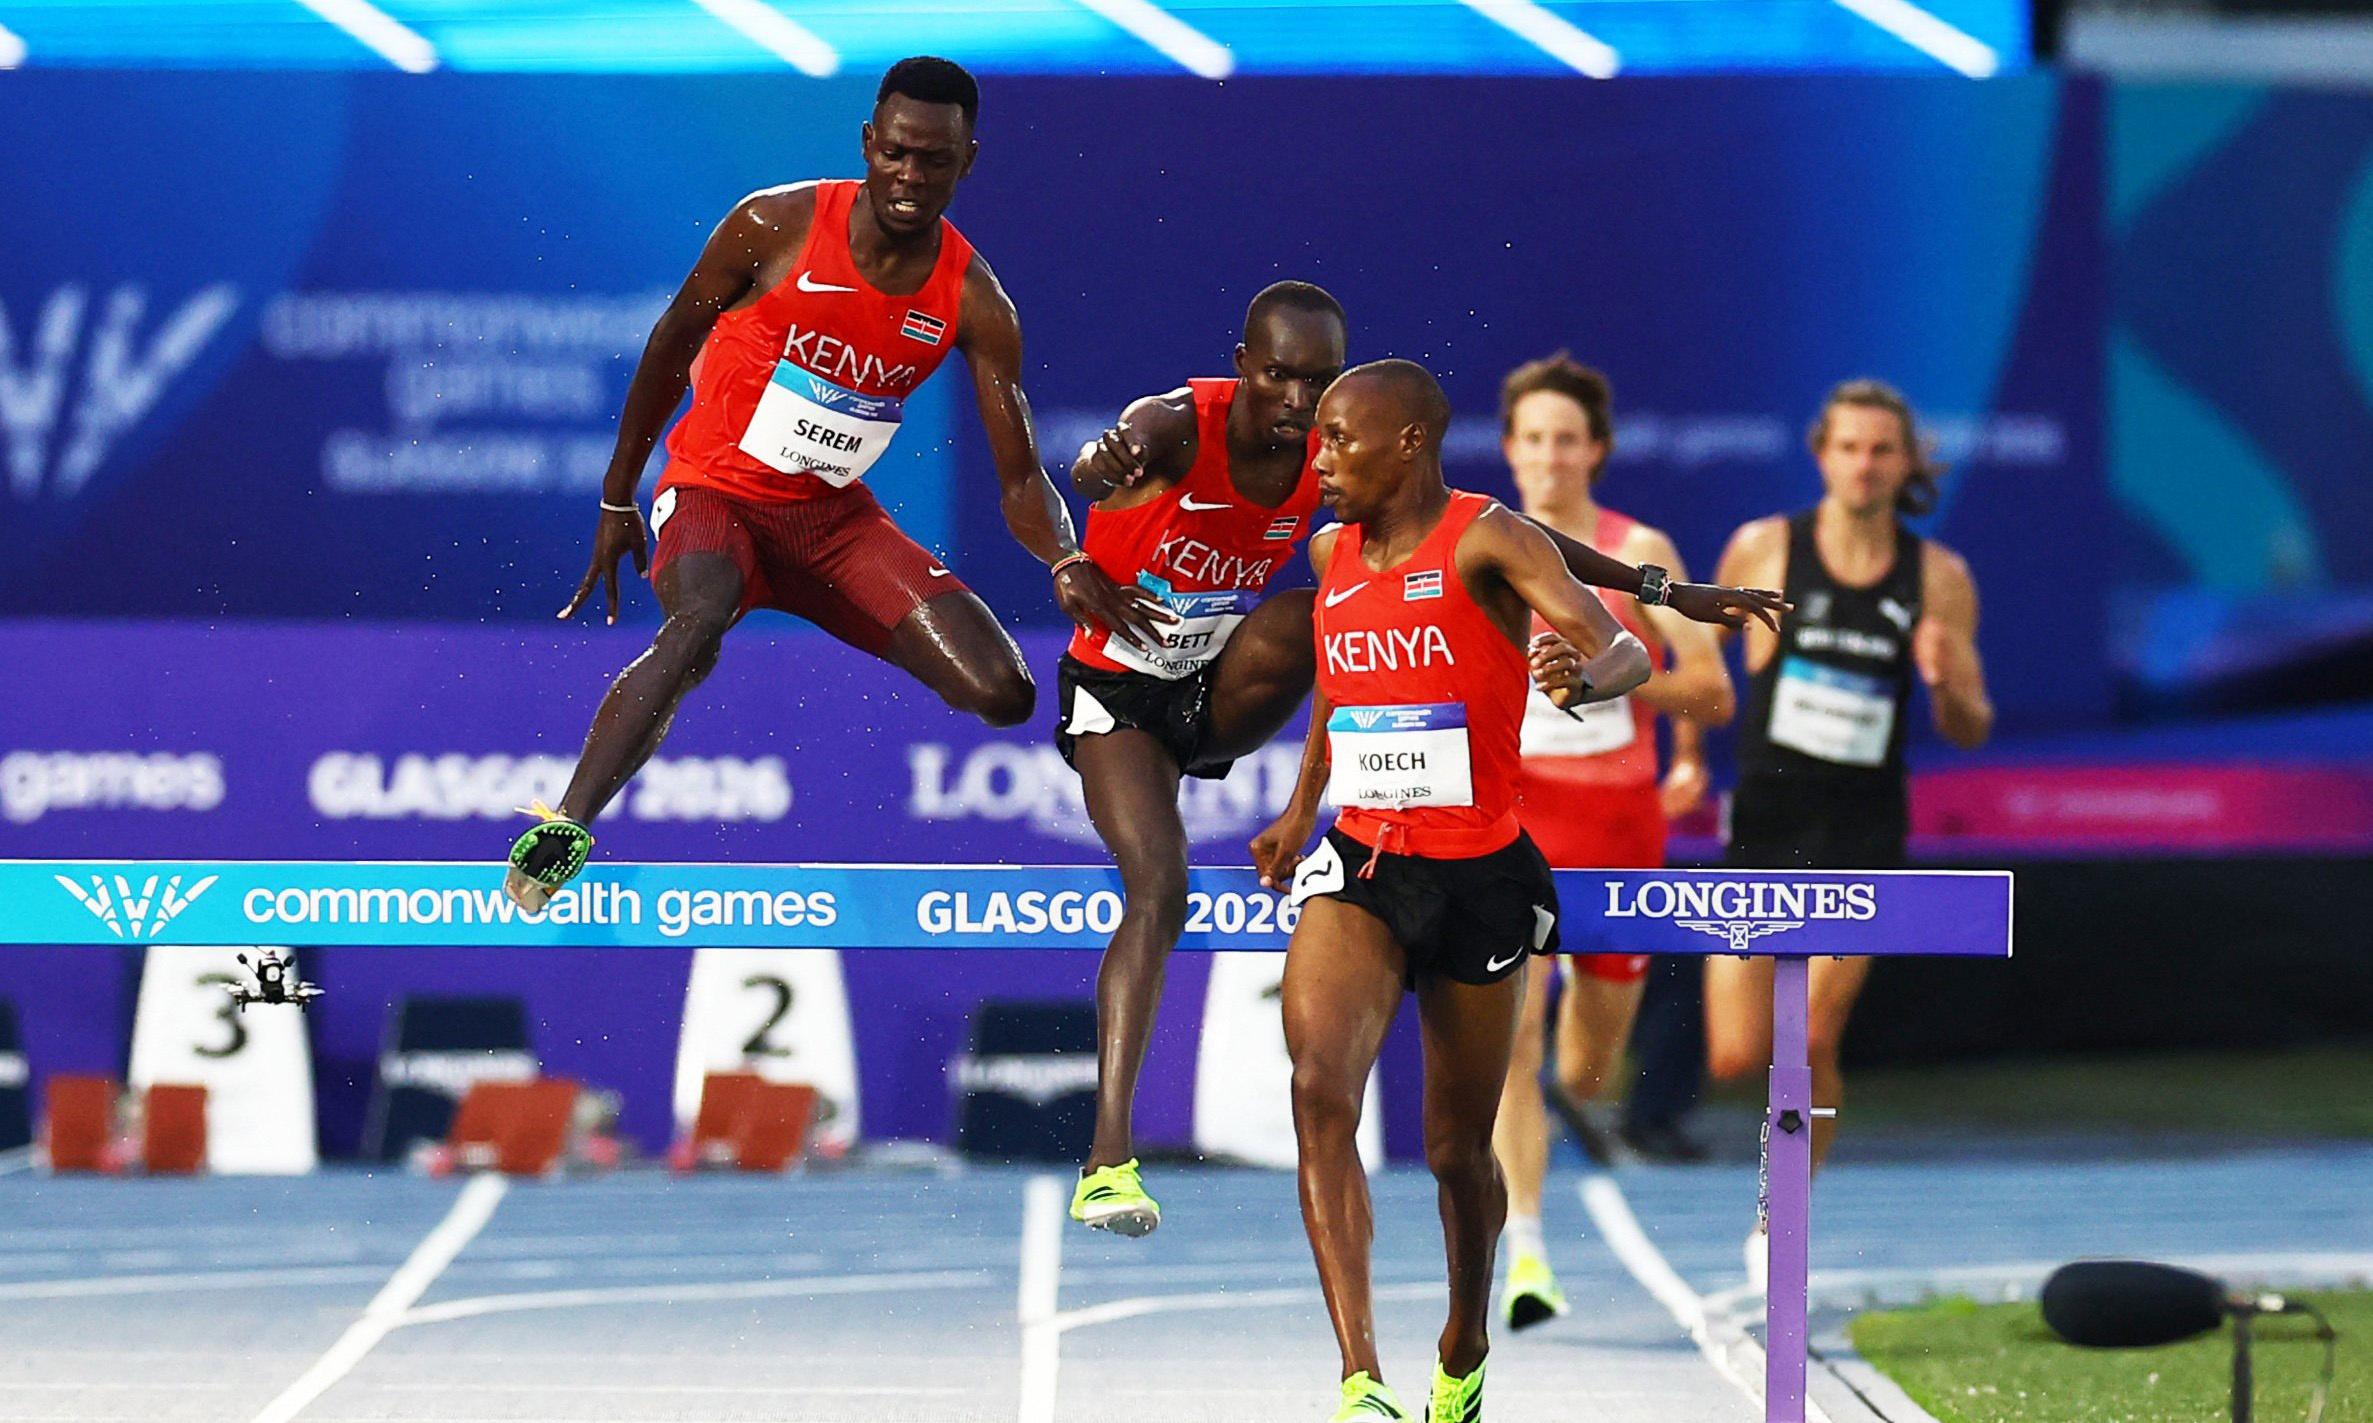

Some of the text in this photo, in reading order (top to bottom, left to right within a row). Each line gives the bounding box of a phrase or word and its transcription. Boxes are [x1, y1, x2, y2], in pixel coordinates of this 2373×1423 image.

[783, 323, 916, 388] KENYA
[793, 418, 863, 453] SEREM
[779, 446, 851, 477] LONGINES
[1152, 529, 1272, 588] KENYA
[1165, 630, 1215, 649] BETT
[1323, 625, 1455, 676] KENYA
[1358, 752, 1426, 772] KOECH
[308, 752, 626, 819] GLASGO
[1358, 786, 1432, 801] LONGINES
[656, 889, 838, 937] games
[916, 890, 1302, 934] GLASGO 2026
[1603, 880, 1877, 921] LONGINES
[194, 971, 248, 1059] 3
[741, 973, 793, 1058] 2
